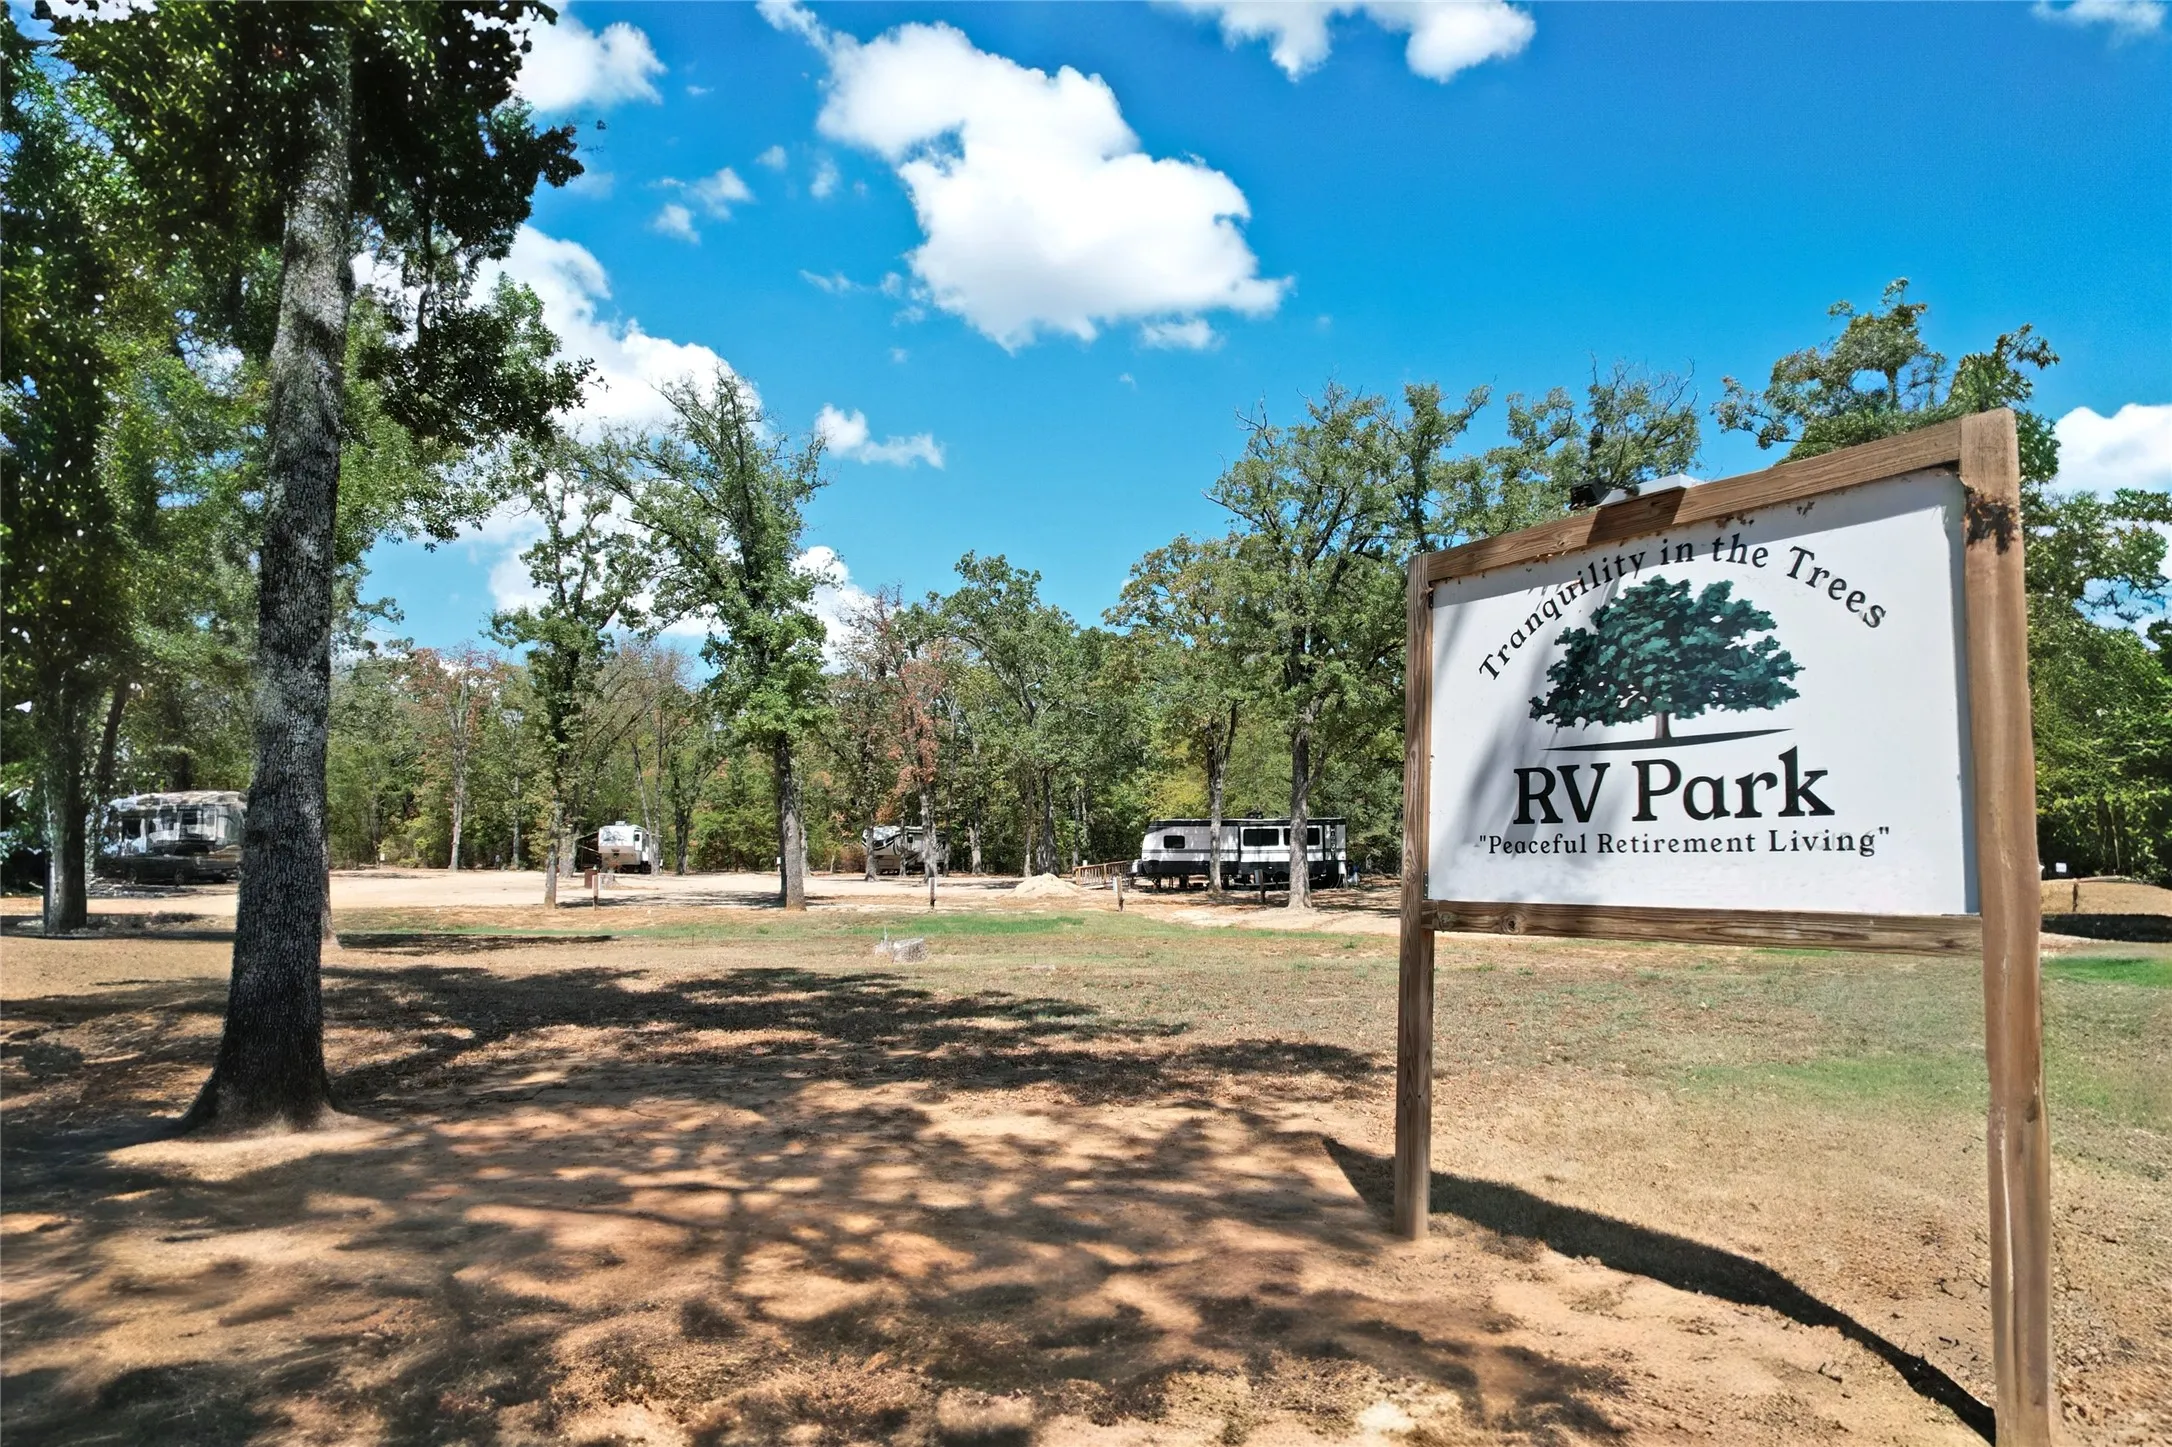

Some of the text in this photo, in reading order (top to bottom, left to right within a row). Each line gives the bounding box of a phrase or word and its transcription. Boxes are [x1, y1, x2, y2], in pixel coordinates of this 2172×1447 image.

[1478, 532, 1887, 681] Tranquility in the Trees
[1512, 745, 1836, 826] RV Park
[1479, 826, 1890, 858] "Peaceful Retirement Living"
